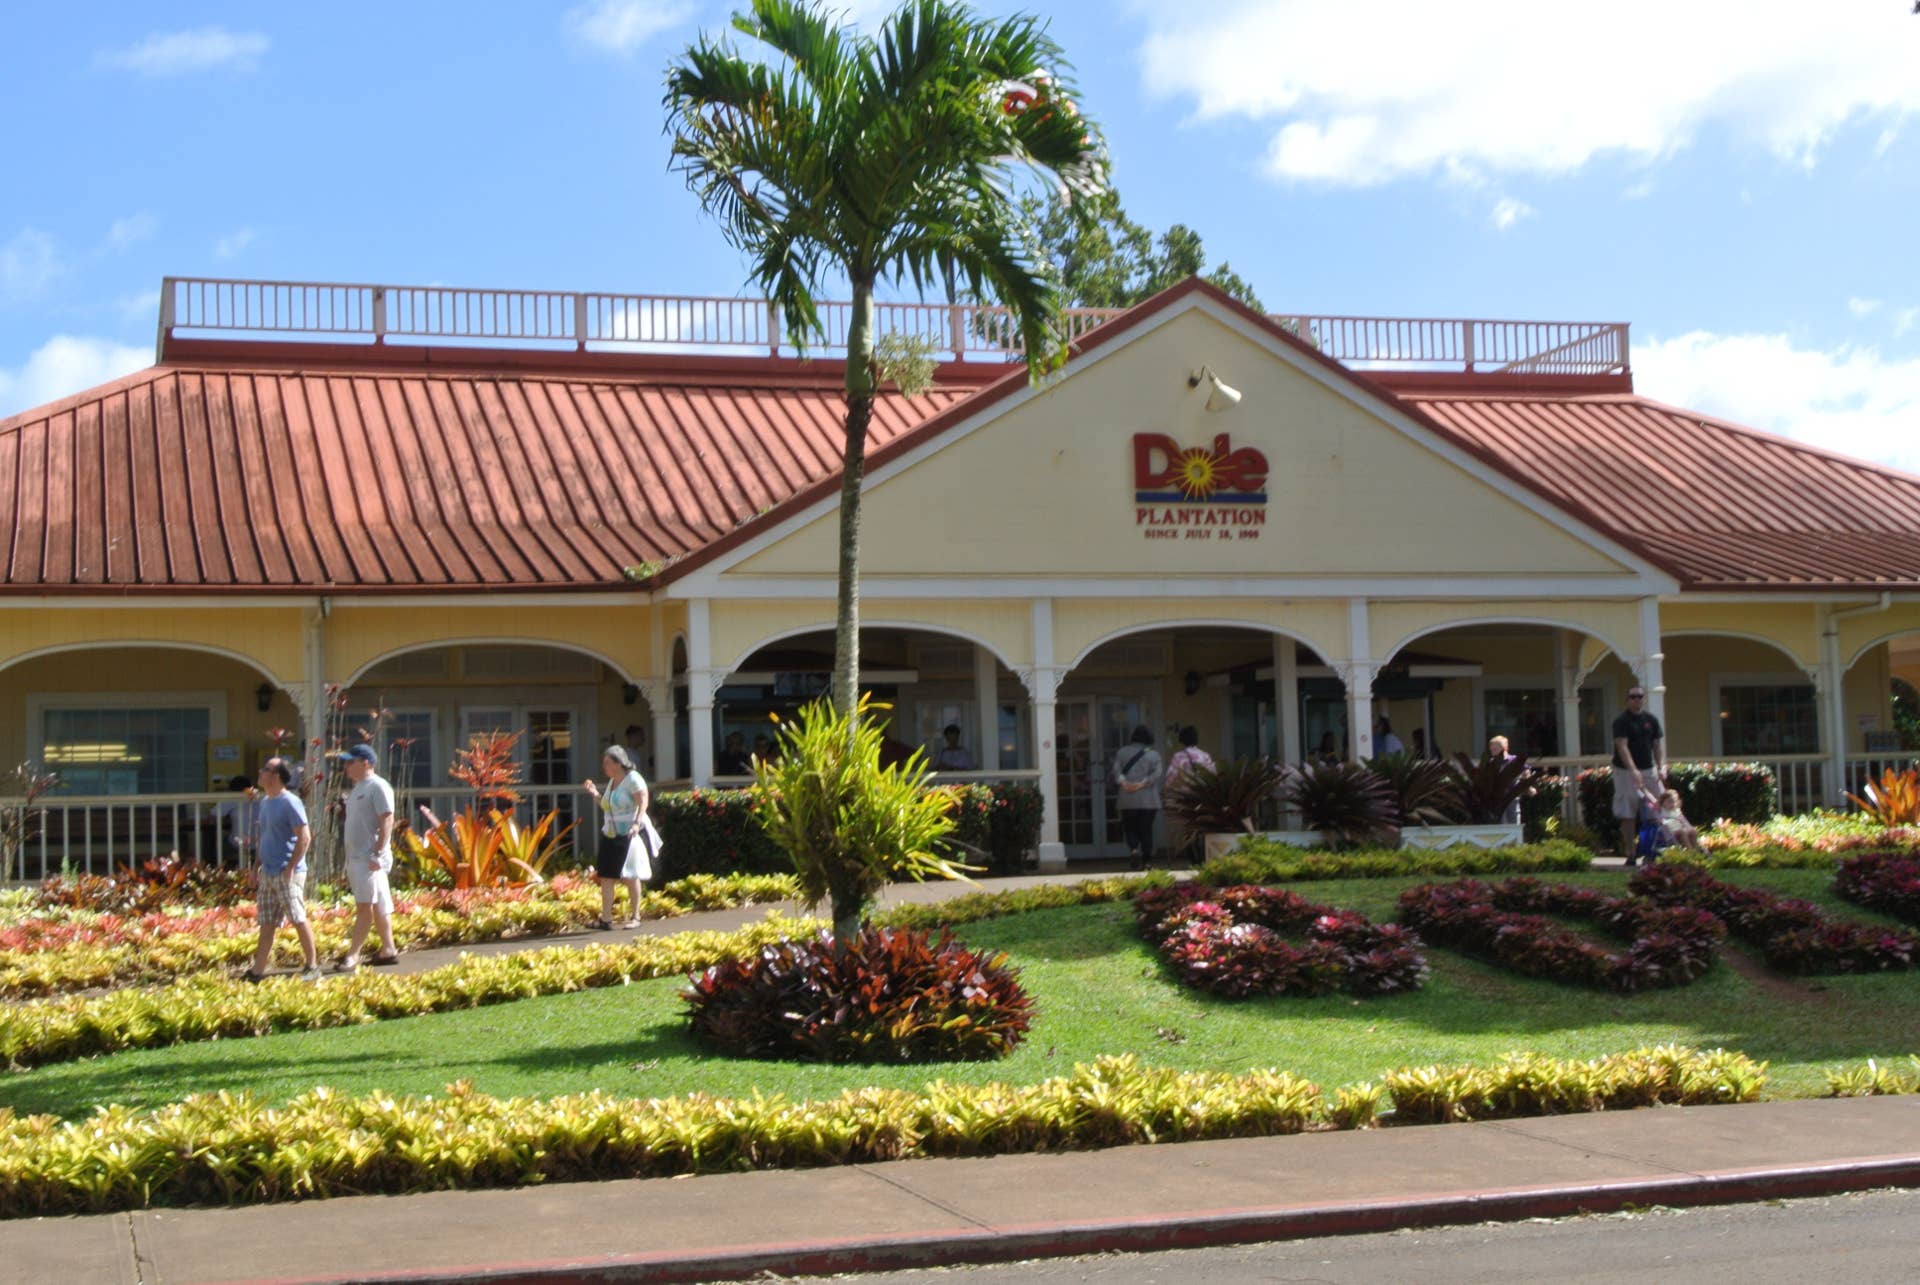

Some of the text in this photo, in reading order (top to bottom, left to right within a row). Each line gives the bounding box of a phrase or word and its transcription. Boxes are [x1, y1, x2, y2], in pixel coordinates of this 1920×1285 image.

[1133, 432, 1269, 493] Dole
[1136, 508, 1265, 525] PLANTATION
[1144, 529, 1178, 539] SINCE
[1185, 529, 1211, 539] JULY
